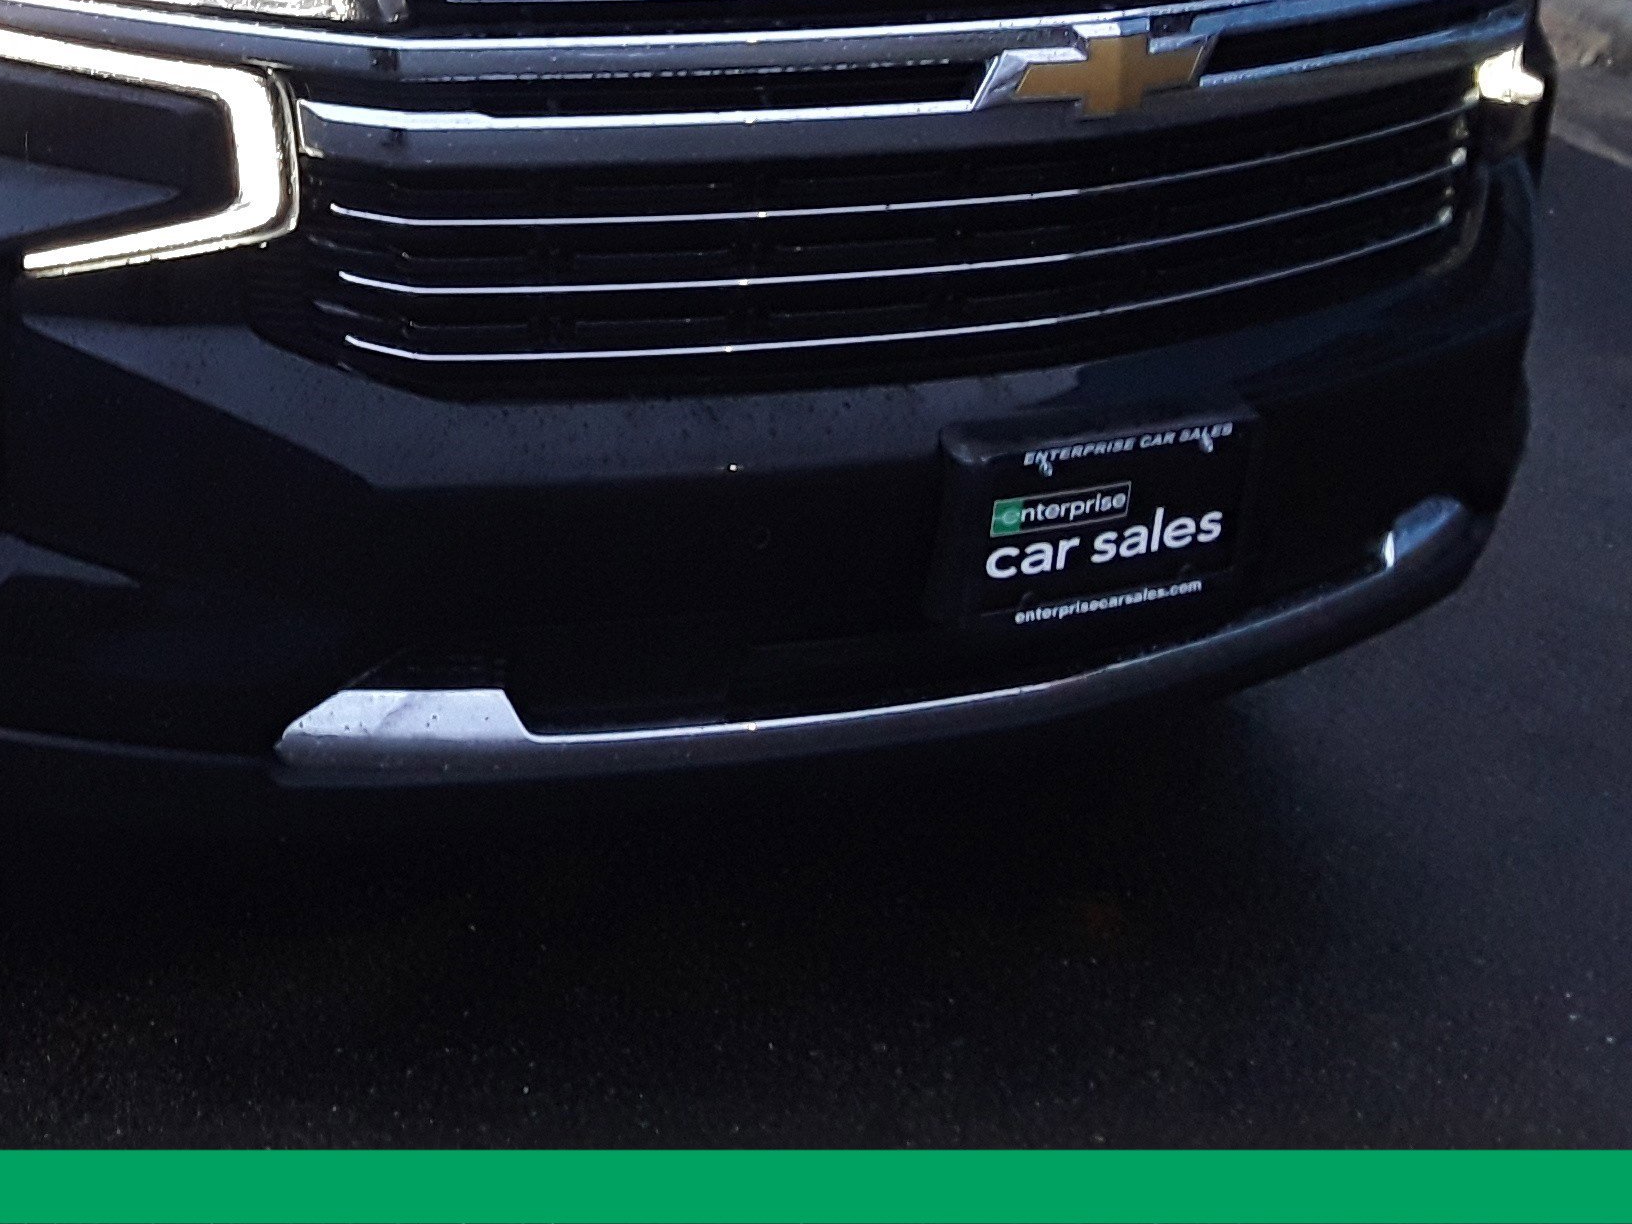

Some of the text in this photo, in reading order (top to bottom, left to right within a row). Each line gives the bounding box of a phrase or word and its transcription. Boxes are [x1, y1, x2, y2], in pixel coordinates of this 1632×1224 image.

[1002, 492, 1127, 525] enterprise
[985, 506, 1223, 579] car sales
[1014, 579, 1203, 625] enterprisecarsales.com
